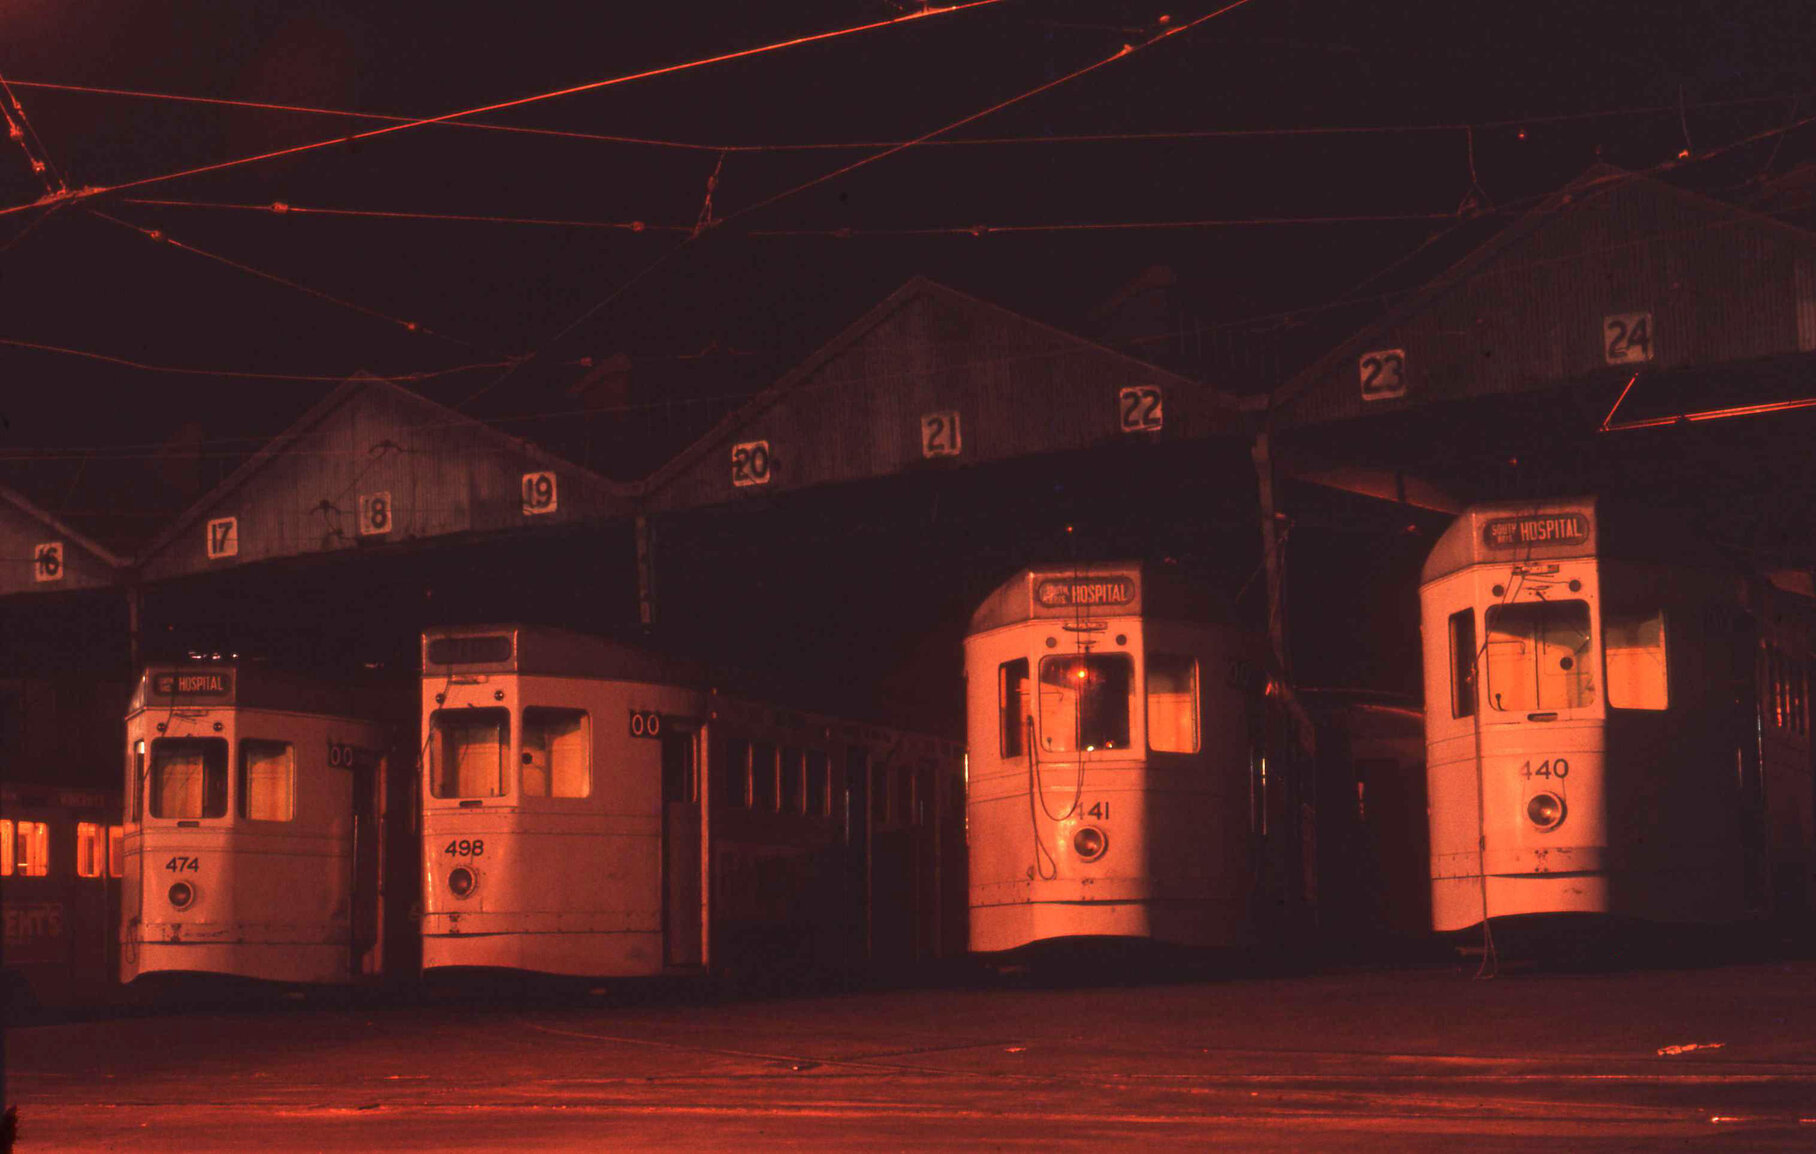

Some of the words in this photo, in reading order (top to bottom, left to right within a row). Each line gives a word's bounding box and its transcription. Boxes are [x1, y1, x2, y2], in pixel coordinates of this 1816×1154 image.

[1606, 318, 1650, 358] 24
[1362, 354, 1405, 392] 23
[1121, 390, 1161, 427] 22
[927, 417, 957, 451] 21
[734, 446, 768, 480] 20
[527, 474, 552, 508] 19
[212, 522, 233, 554] 17
[1520, 518, 1582, 541] HOSPITAL
[39, 547, 59, 576] 16
[1072, 583, 1126, 604] HOSPITAL
[178, 676, 224, 691] HOSPITAL
[632, 713, 660, 736] 00
[1519, 758, 1569, 780] 440
[445, 839, 484, 857] 498
[166, 857, 199, 872] 474
